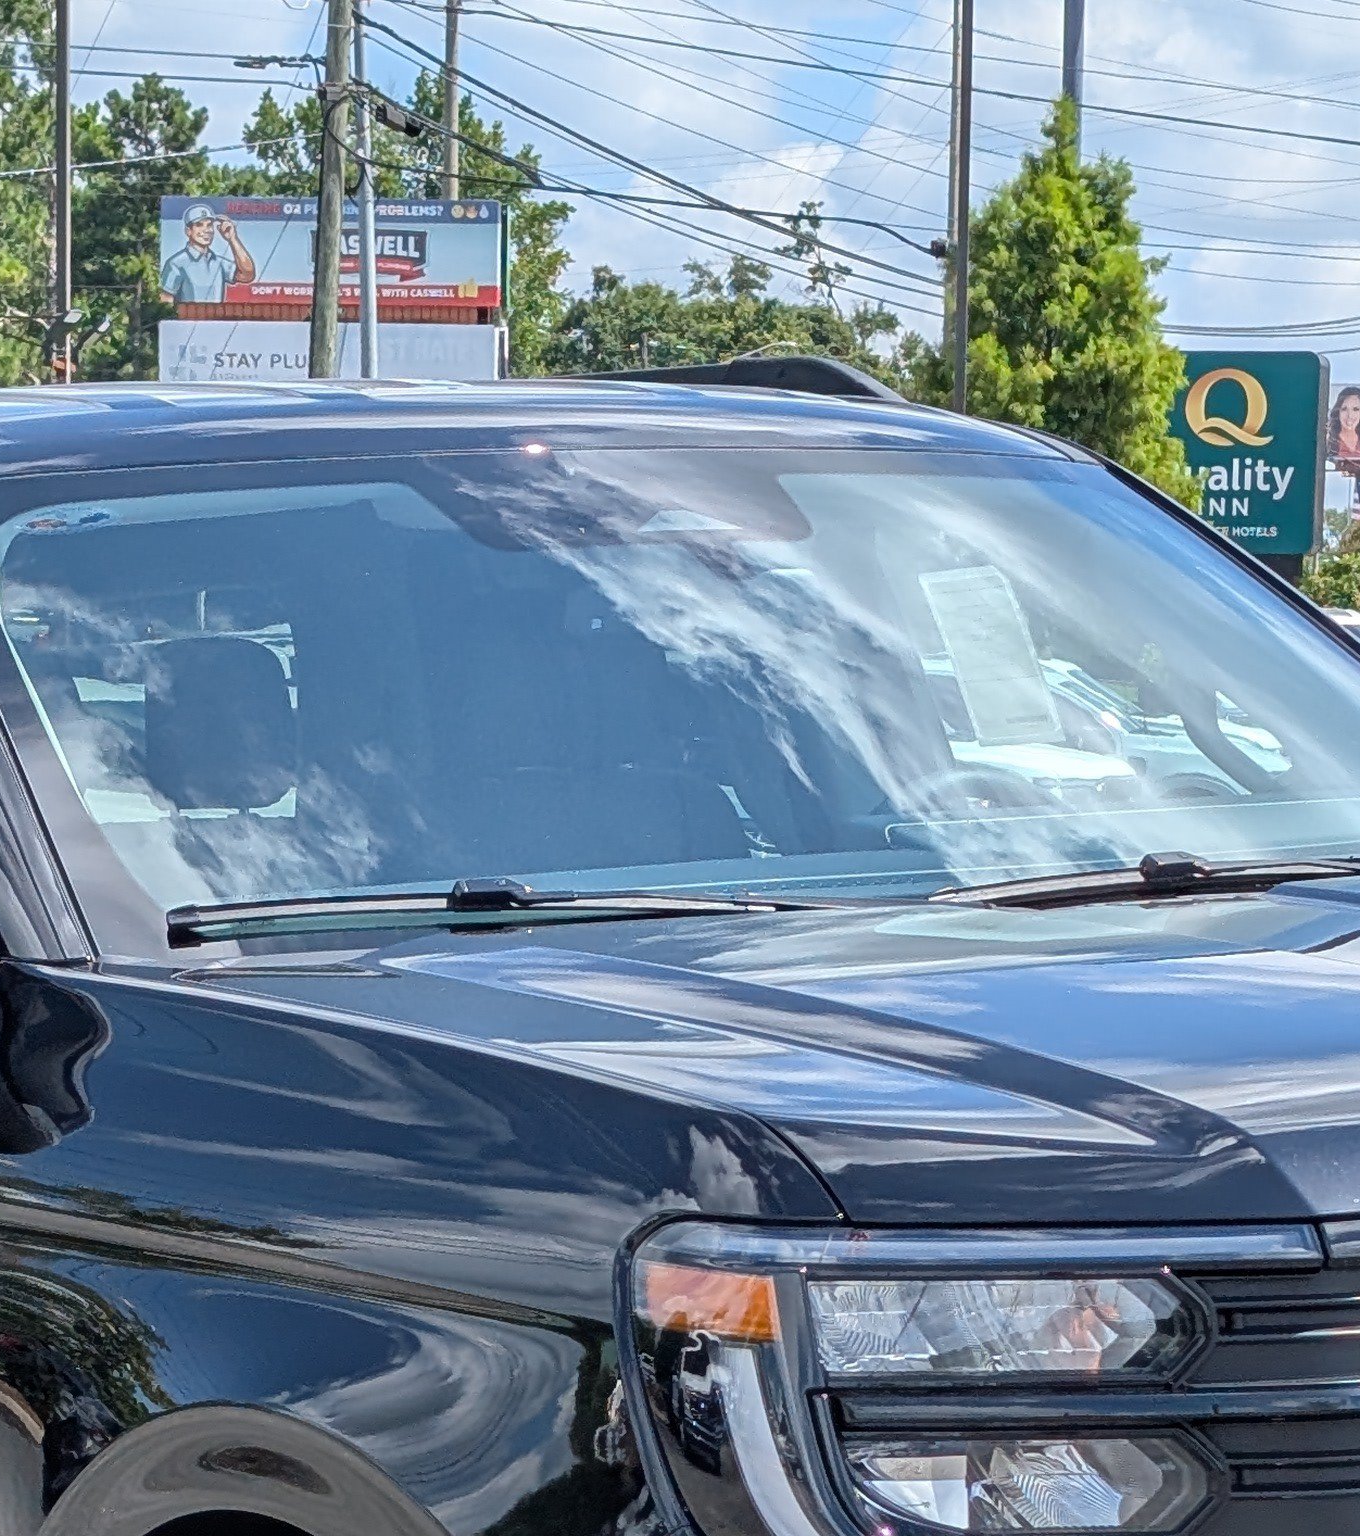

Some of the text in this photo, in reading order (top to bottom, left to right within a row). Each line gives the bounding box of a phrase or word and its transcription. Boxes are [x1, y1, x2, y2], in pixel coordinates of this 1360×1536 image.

[283, 286, 314, 296] WORR
[214, 352, 309, 370] STAY PLU
[1185, 458, 1295, 501] uality
[1232, 526, 1278, 538] HOTELS
